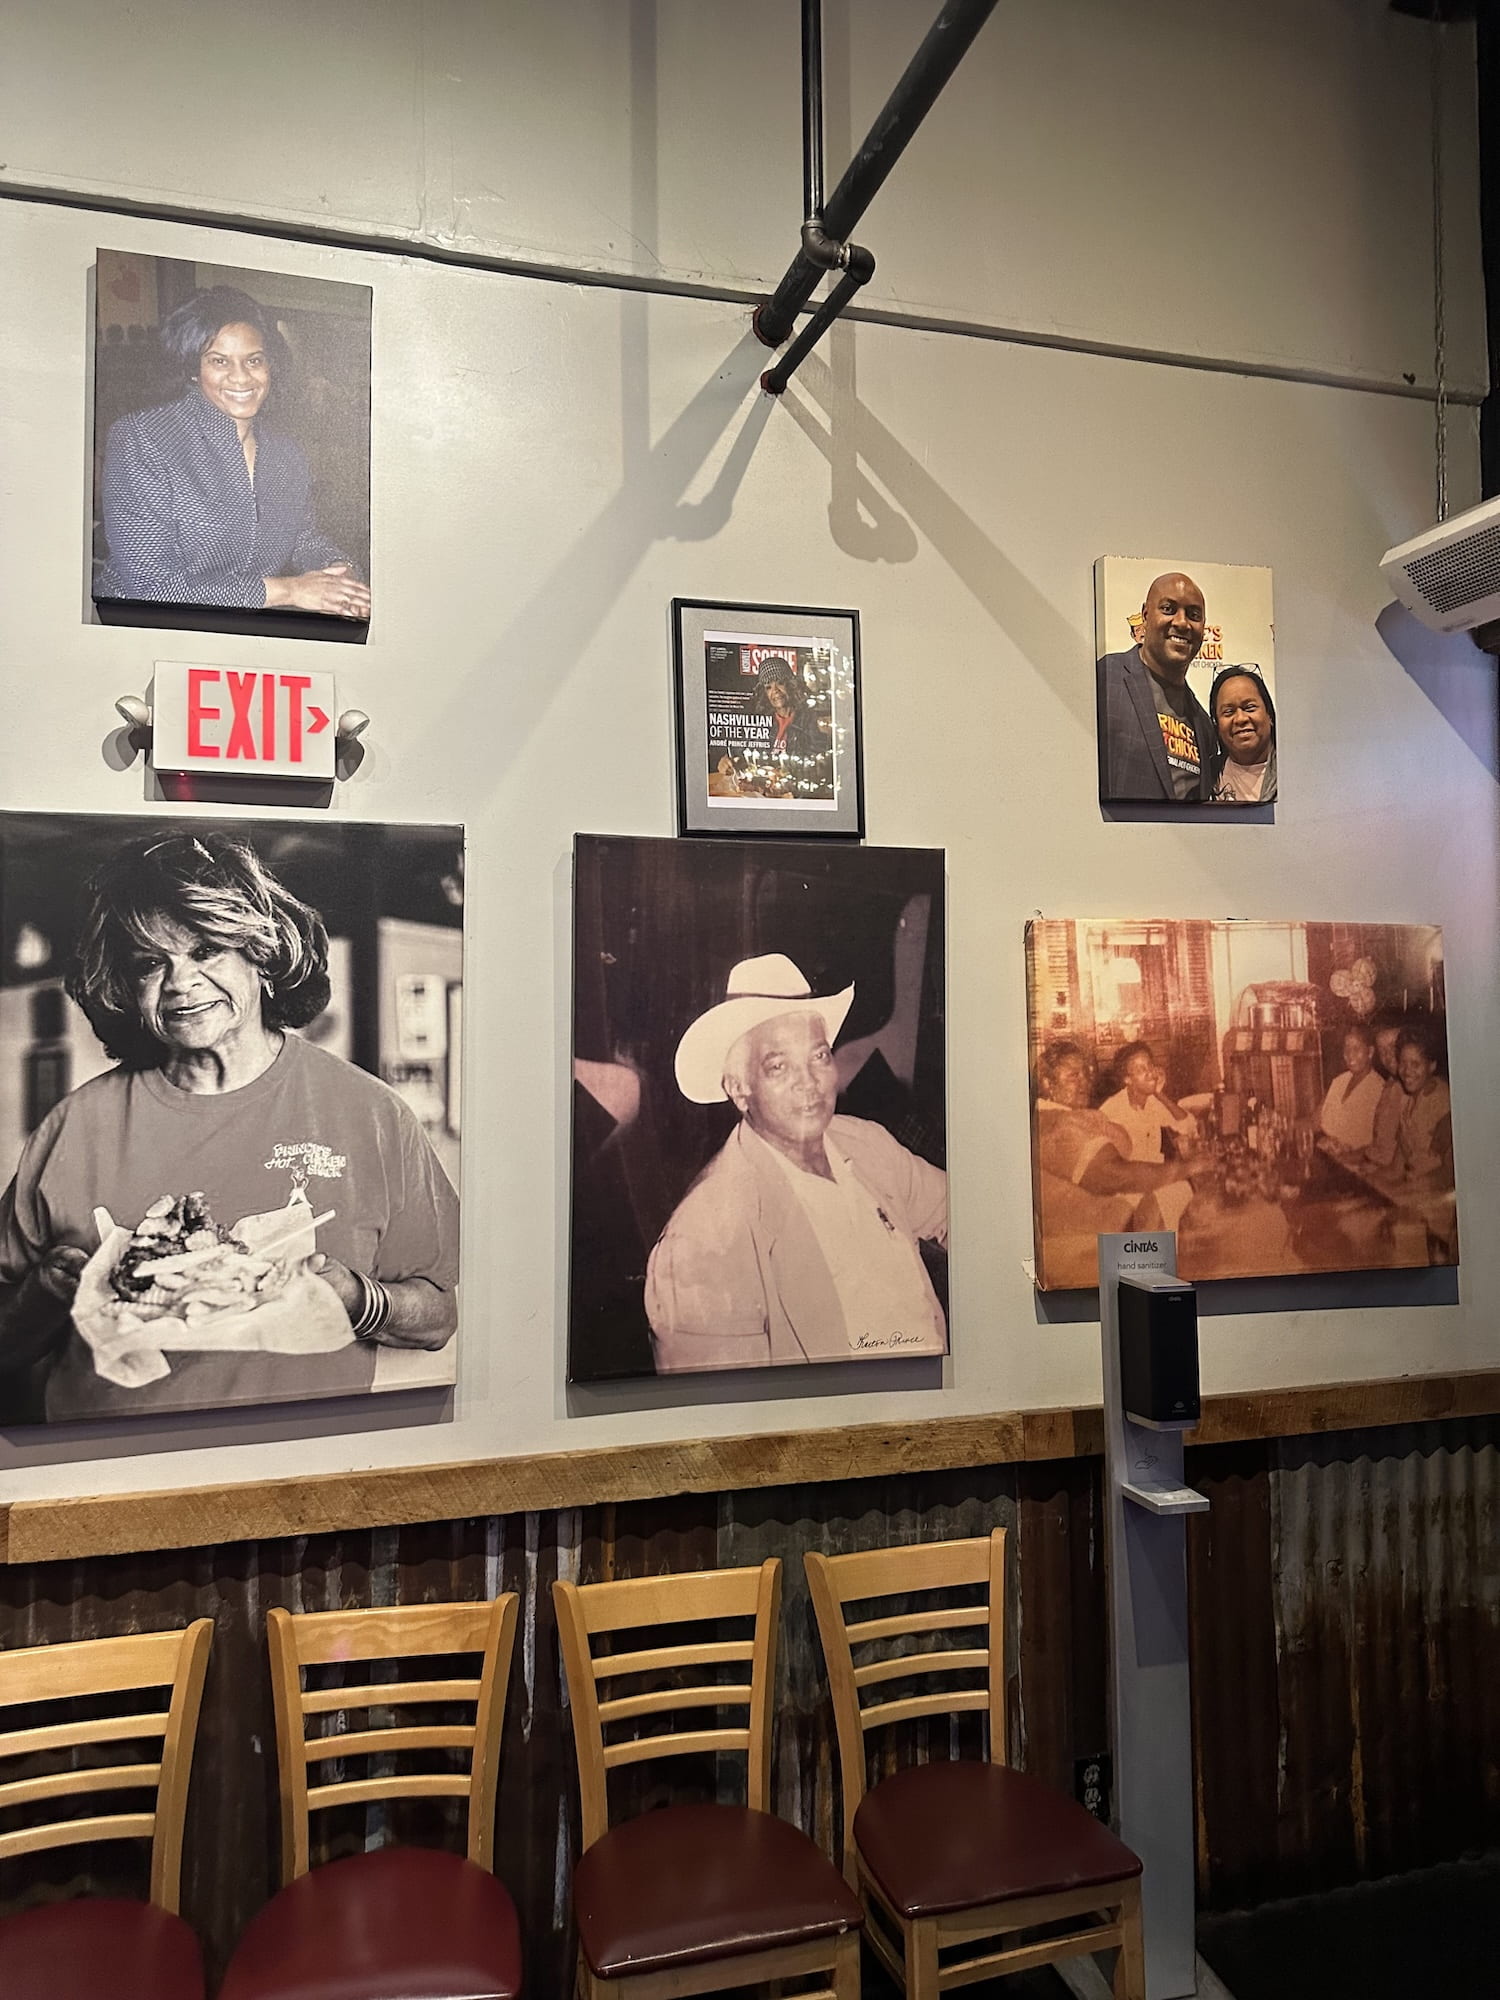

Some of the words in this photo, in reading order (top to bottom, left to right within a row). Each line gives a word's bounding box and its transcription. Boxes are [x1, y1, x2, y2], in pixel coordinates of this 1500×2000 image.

[188, 669, 311, 763] EXIT
[709, 713, 773, 727] NASHVILLIAN
[709, 726, 722, 737] OF
[724, 726, 743, 739] THE
[743, 727, 770, 739] YEAR
[1168, 736, 1200, 762] CHICKE
[1117, 1261, 1136, 1271] hand
[1137, 1261, 1167, 1270] sanitizer
